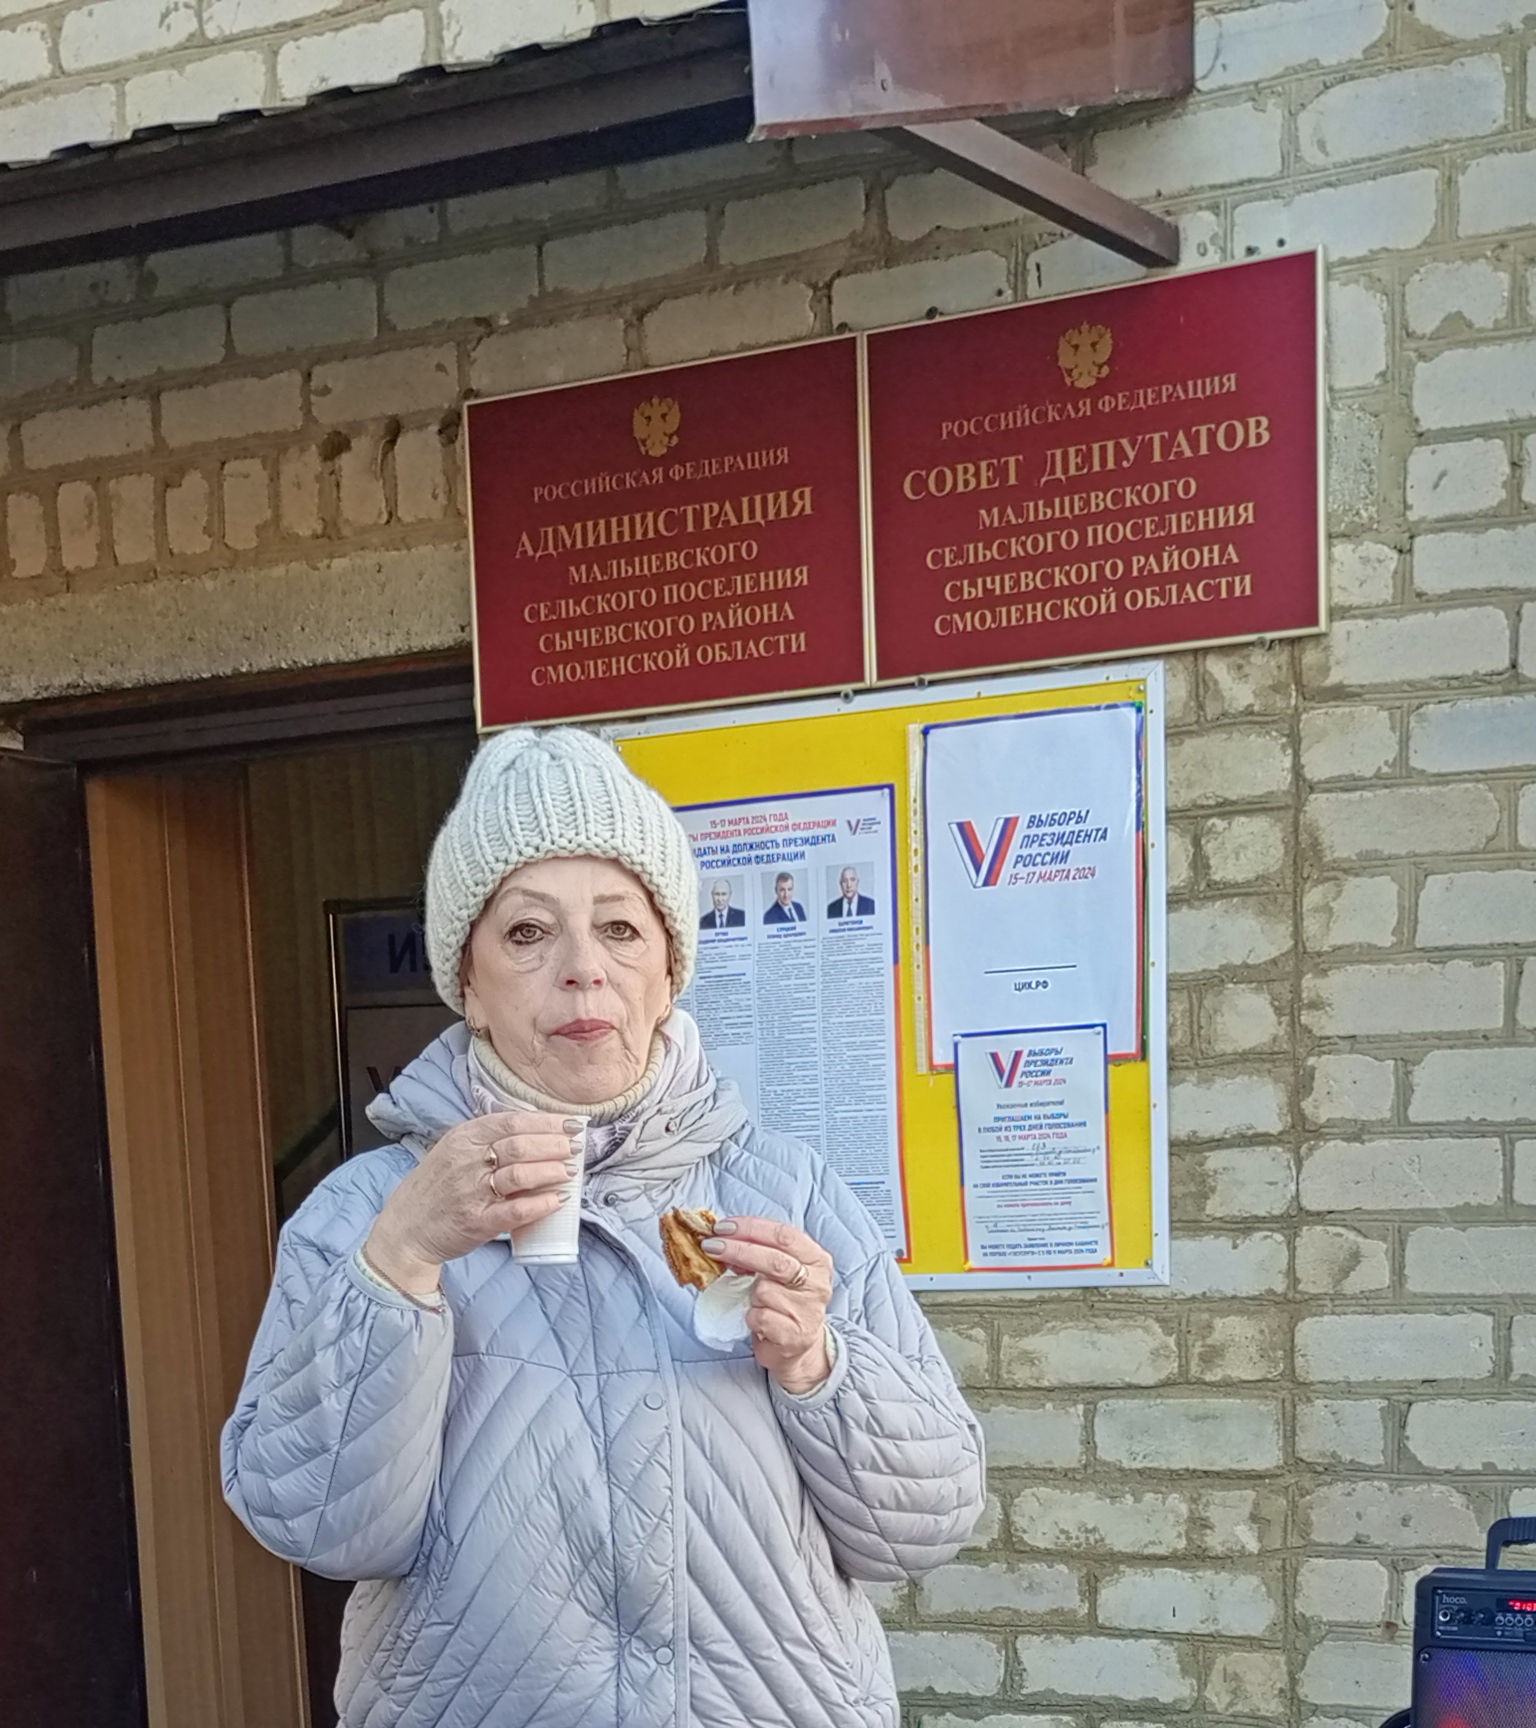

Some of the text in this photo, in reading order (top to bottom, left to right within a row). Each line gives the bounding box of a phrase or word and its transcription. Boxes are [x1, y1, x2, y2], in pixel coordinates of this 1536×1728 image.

[941, 373, 1237, 440] РОССИЙСКАЯ ФЕДЕРАЦИЯ
[533, 447, 789, 503] РОССИЙСКАЯ ФЕДЕРАЦИЯ
[903, 415, 1271, 500] СОВЕТ ДЕПУТАТОВ
[515, 486, 814, 561] АДМИНИСТРАЦИЯ
[978, 477, 1196, 530] МАЛЬЦЕВСКОГО
[568, 540, 758, 585] МАЛЬЦЕВСКОГО
[926, 502, 1255, 570] СЕЛЬСКОГО ПОСЕЛЕНИЯ
[524, 566, 809, 623] СЕЛЬСКОГО ПОСЕЛЕНИЯ
[944, 543, 1239, 602] СЫЧЕВСКОГО РАЙОНА
[539, 601, 795, 653] СЫЧЕВСКОГО РАЙОНА
[934, 574, 1253, 636] СМОЛЕНСКОЙ ОБЛАСТИ
[531, 632, 807, 686] СМОЛЕНСКОЙ ОБЛАСТИ
[769, 812, 789, 822] ГОДА
[1019, 827, 1108, 849] ПРЕЗИДЕНТА
[1026, 809, 1090, 829] ВЫБОРЫ
[700, 850, 806, 870] РОССИЙСКОЙ ФЕДЕРАЦИИ
[720, 844, 730, 855] НА
[731, 839, 781, 855] ДОЛЖНОСТЬ
[782, 833, 837, 848] ПРЕЗИДЕНТА
[1013, 850, 1071, 869] РОССИИ
[1037, 868, 1070, 883] МАРТА
[1072, 866, 1096, 880] 2024
